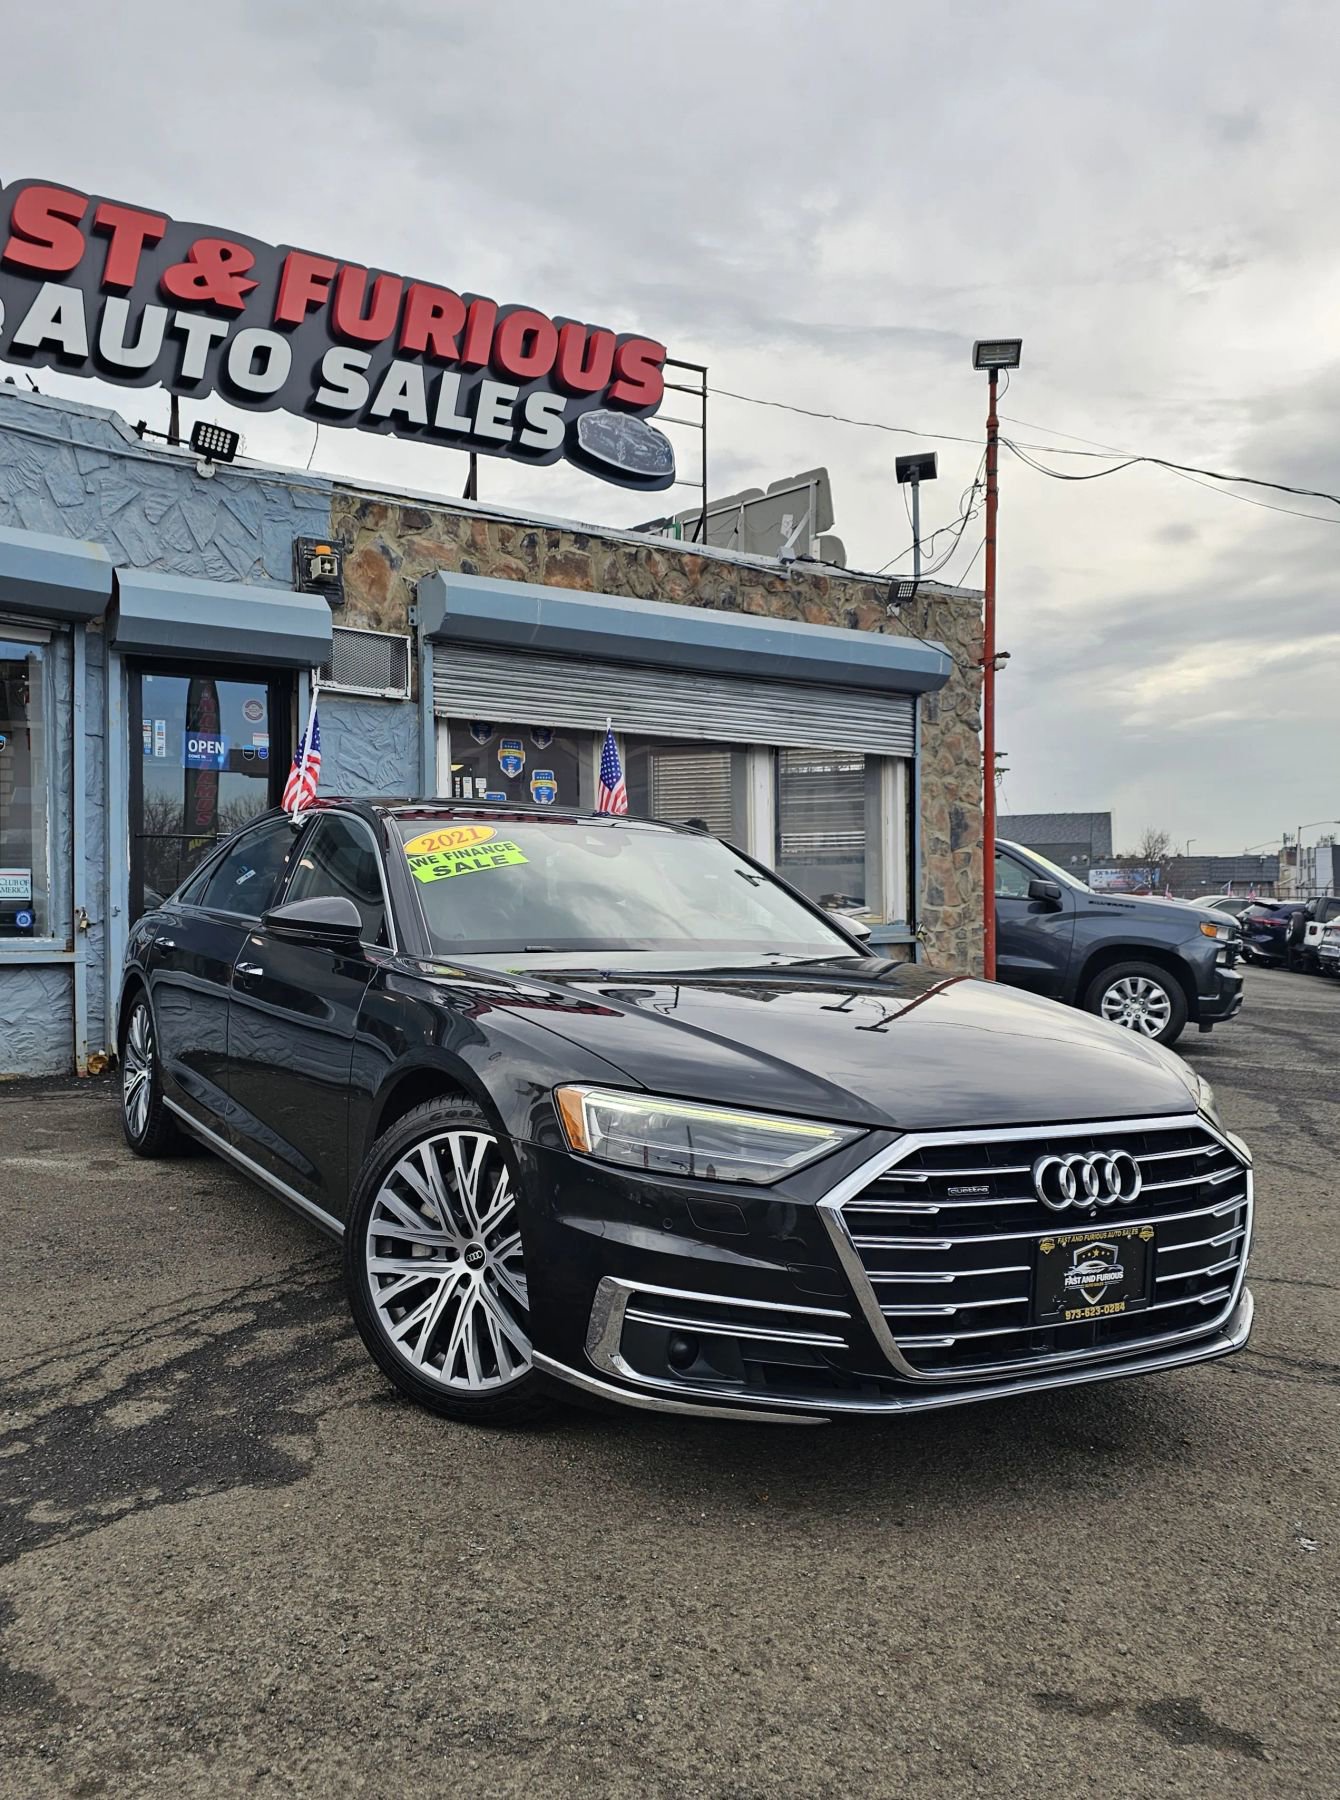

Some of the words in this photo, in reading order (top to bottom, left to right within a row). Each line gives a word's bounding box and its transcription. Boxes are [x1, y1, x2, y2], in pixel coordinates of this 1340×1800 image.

[160, 238, 260, 317] &
[274, 250, 667, 406] FURIOUS
[13, 281, 292, 394] AUTO
[316, 346, 568, 450] SALES
[188, 739, 225, 754] OPEN
[421, 826, 482, 852] 2021
[412, 855, 440, 868] WE
[443, 842, 515, 861] FINANCE
[433, 854, 509, 876] SALE
[1057, 1235, 1071, 1244] FAST
[1071, 1235, 1083, 1243] AND
[1084, 1233, 1107, 1241] FURIOUS
[1108, 1230, 1122, 1239] AUTO
[1122, 1228, 1139, 1237] SALES
[1064, 1276, 1081, 1286] FAST
[1081, 1275, 1096, 1284] AND
[1096, 1271, 1124, 1282] FURIOUS
[1065, 1302, 1125, 1320] 973-623-0284
